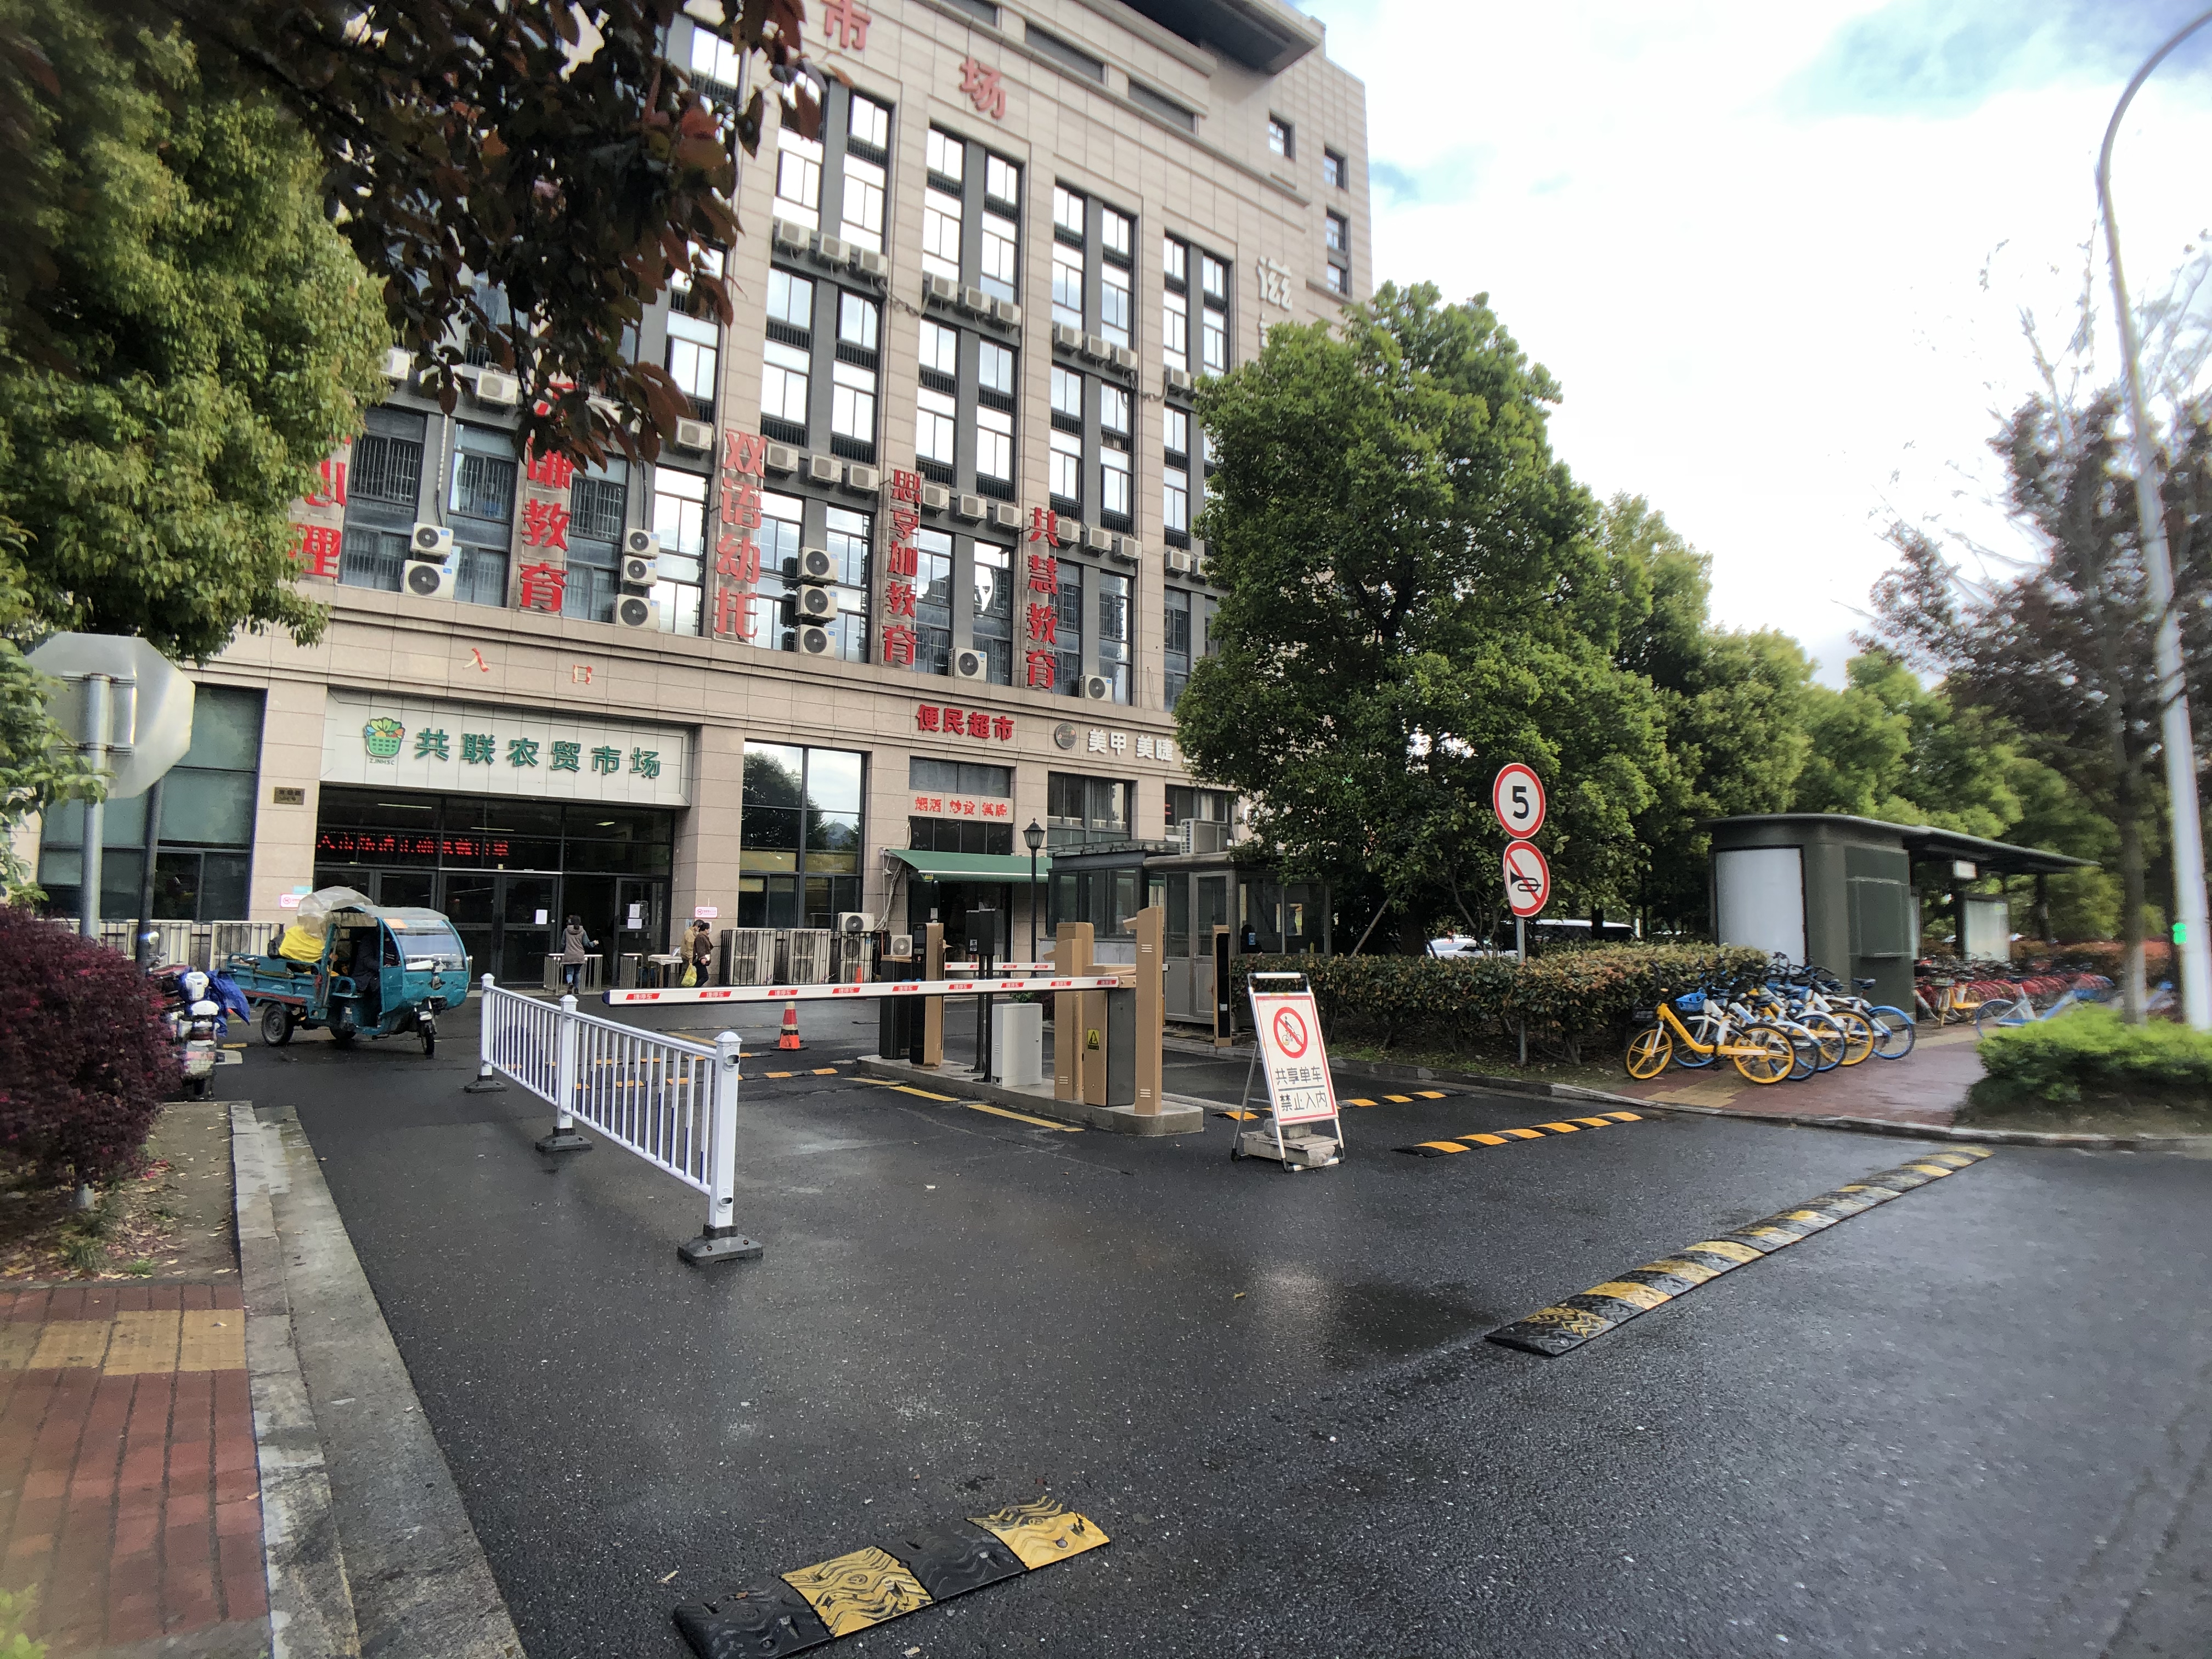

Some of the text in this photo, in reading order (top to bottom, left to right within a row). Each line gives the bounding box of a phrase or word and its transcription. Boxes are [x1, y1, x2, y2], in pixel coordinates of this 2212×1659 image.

[713, 428, 767, 639] 双语幼托
[462, 647, 592, 685] 入口
[916, 704, 1015, 741] 便民超市
[414, 727, 662, 778] 共联农贸市场
[1088, 728, 1174, 761] 美甲 美睫
[915, 796, 942, 813] 烟酒
[981, 802, 1008, 817] 棋牌
[1511, 786, 1530, 819] 5
[1275, 1065, 1322, 1085] 共享单车
[1279, 1091, 1328, 1112] 禁止入内
